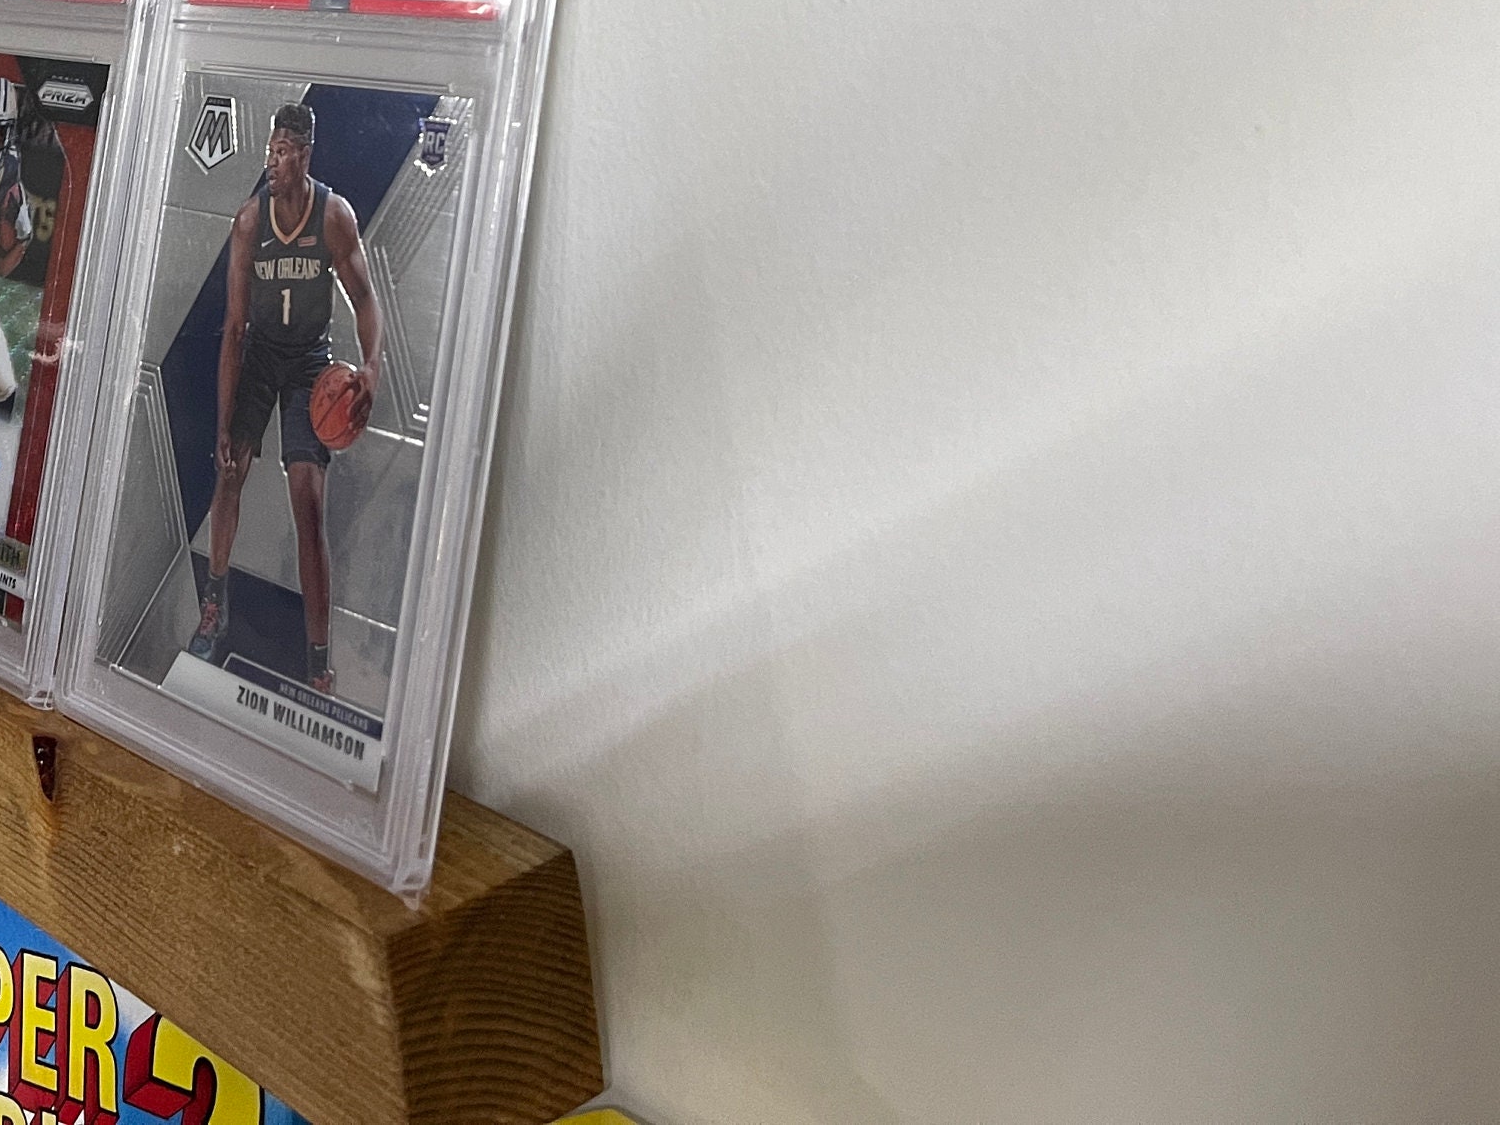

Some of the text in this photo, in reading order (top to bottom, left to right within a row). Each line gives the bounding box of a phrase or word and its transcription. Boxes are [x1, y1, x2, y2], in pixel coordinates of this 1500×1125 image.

[41, 90, 87, 105] PRIZM
[277, 258, 320, 279] ORLEANS
[281, 288, 292, 325] 1
[236, 685, 365, 761] ZION WILLIAMSON
